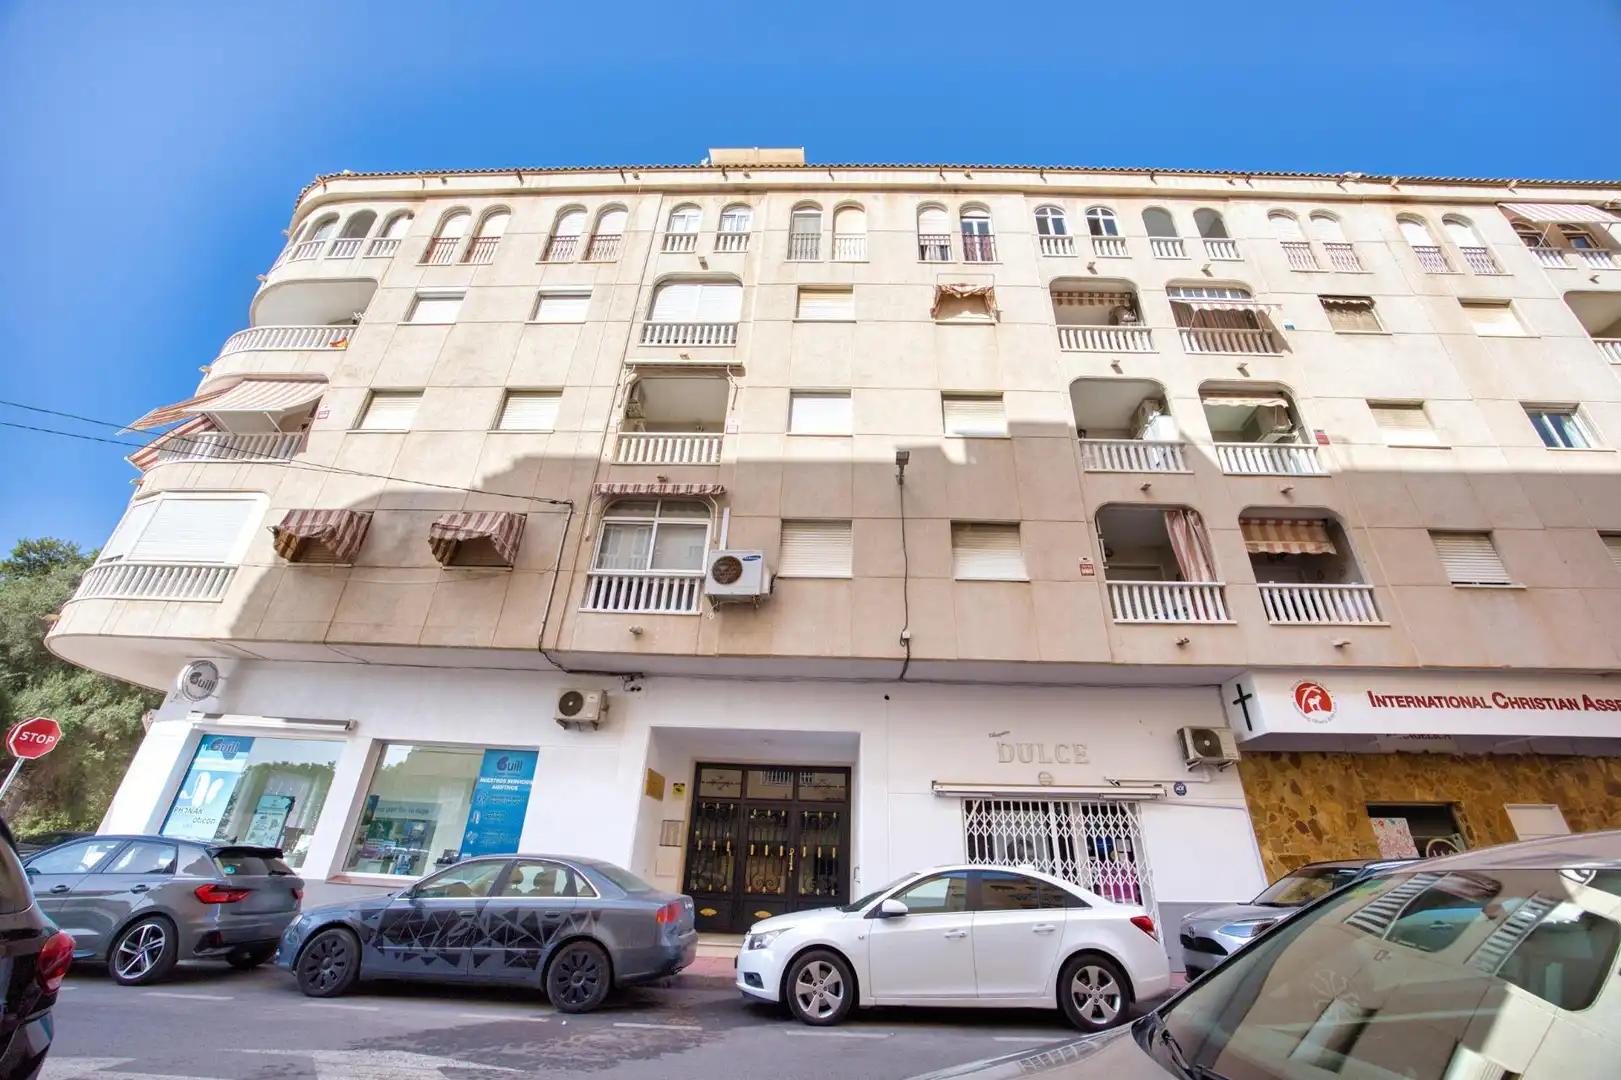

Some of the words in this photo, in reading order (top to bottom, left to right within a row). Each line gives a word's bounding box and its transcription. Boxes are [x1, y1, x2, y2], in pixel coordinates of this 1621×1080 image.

[189, 671, 216, 692] Guill
[1367, 690, 1492, 709] INTERNATIONAL
[1491, 691, 1581, 711] CHRISTIAN
[19, 731, 55, 745] STOP
[210, 738, 240, 754] Guill
[997, 742, 1090, 764] DULCE
[496, 755, 523, 772] Guill
